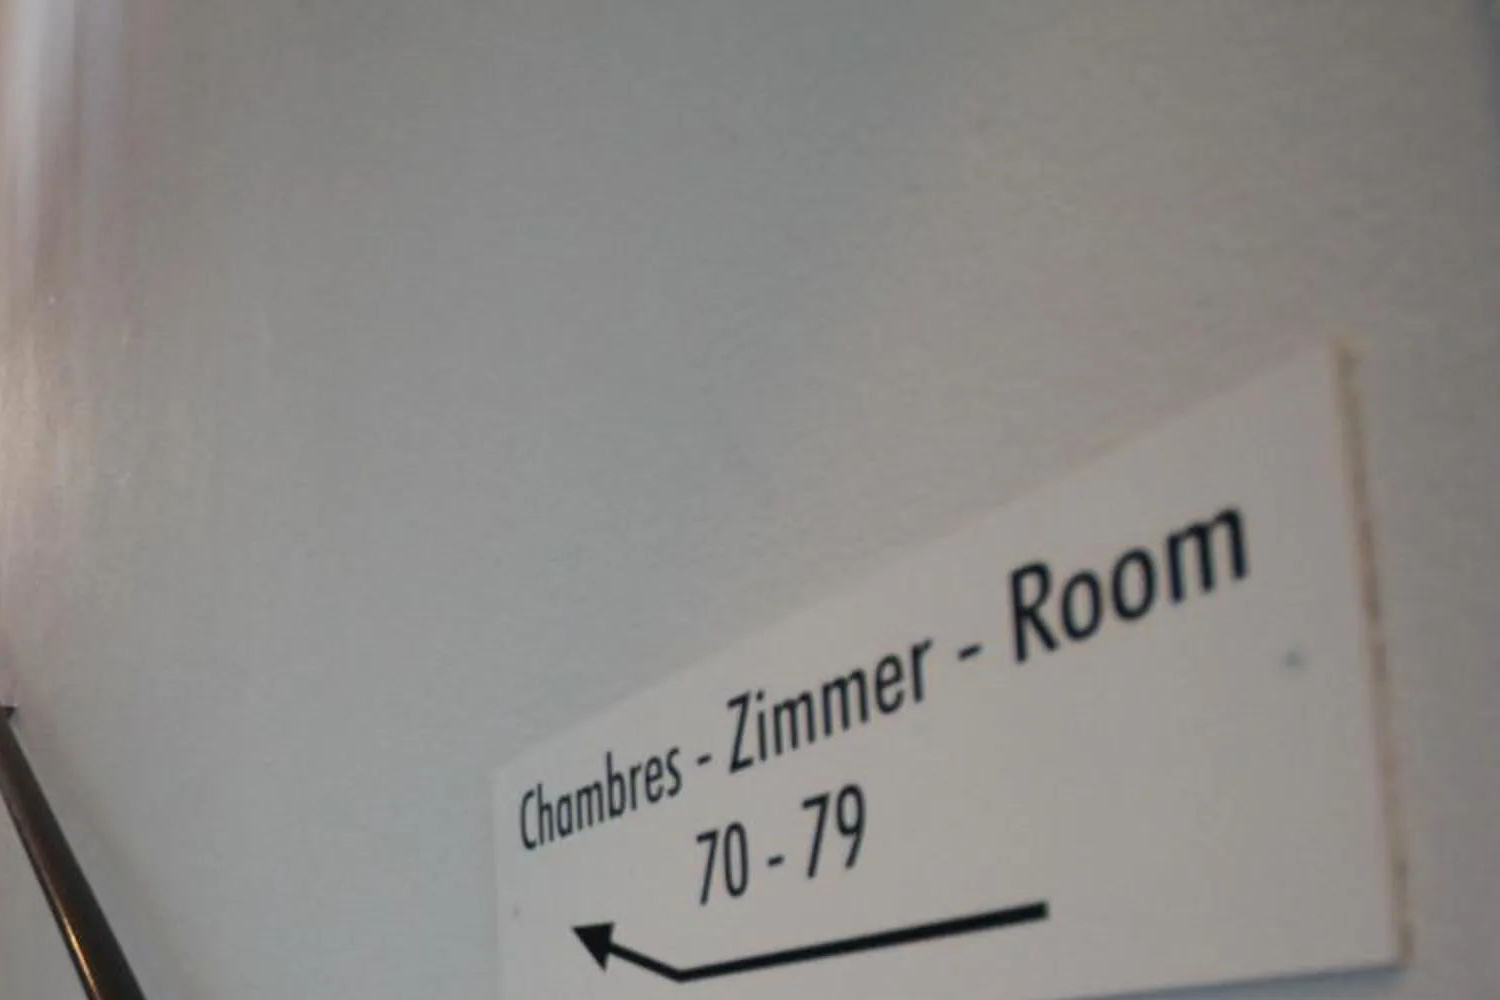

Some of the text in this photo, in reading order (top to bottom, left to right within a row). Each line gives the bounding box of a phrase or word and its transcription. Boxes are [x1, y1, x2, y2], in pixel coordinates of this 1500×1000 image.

[518, 744, 685, 852] Chambres
[725, 637, 934, 775] Zimmer
[1007, 506, 1250, 666] Room
[695, 820, 750, 907] 70
[799, 782, 867, 881] 79
